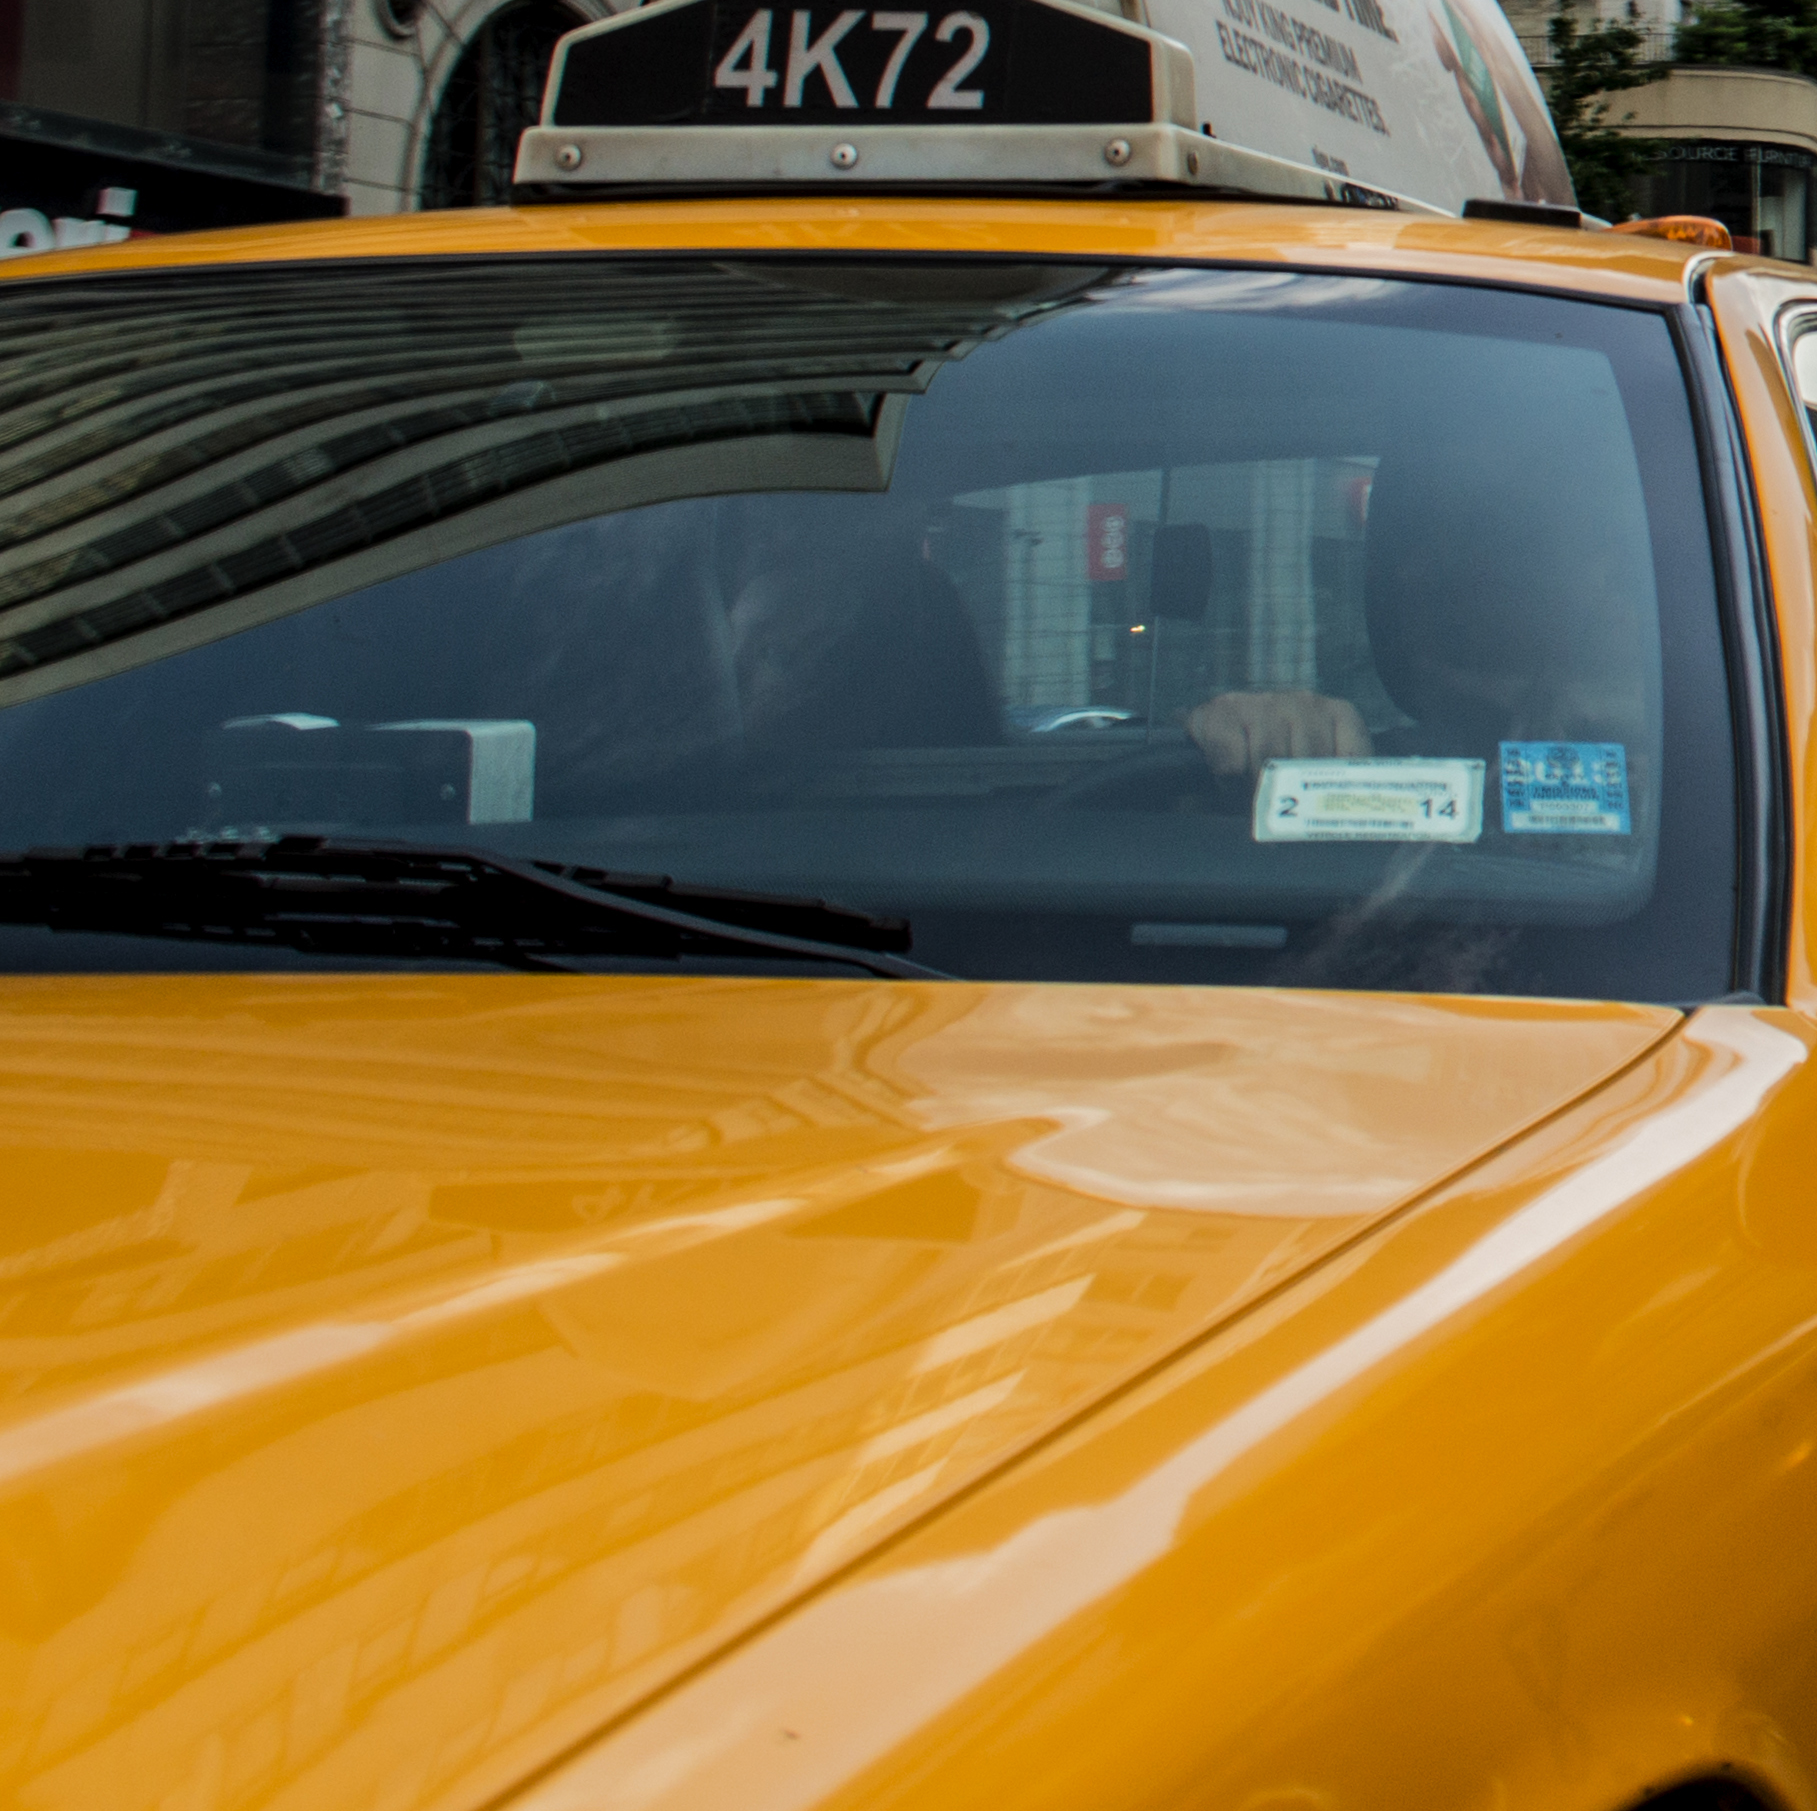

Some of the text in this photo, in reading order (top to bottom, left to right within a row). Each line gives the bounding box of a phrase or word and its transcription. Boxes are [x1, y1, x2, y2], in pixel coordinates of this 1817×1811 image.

[714, 7, 991, 110] 4K72
[1214, 18, 1308, 100] ELECTRONIC
[1288, 15, 1364, 86] PREMIUM
[1277, 796, 1300, 818] 2
[1419, 798, 1460, 820] 14
